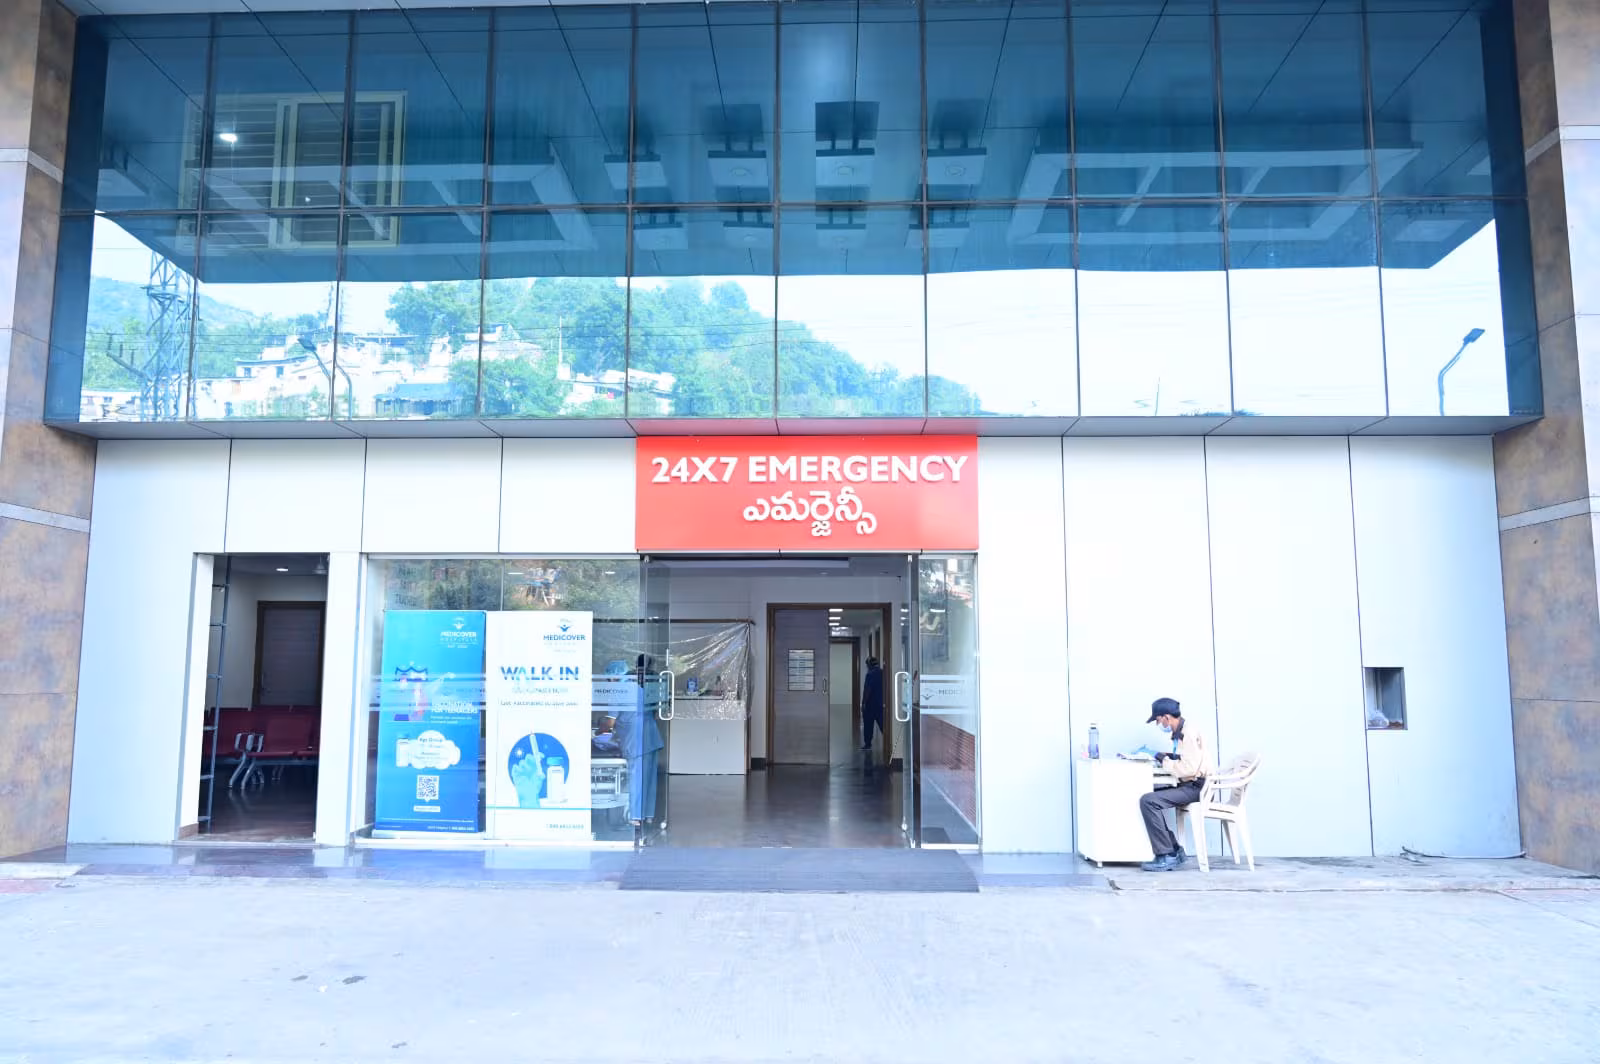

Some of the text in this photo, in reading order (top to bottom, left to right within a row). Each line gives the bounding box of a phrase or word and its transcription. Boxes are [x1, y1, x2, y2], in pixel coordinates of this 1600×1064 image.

[651, 455, 968, 482] 24X7 EMERGENCY
[500, 666, 579, 681] WALK IN
